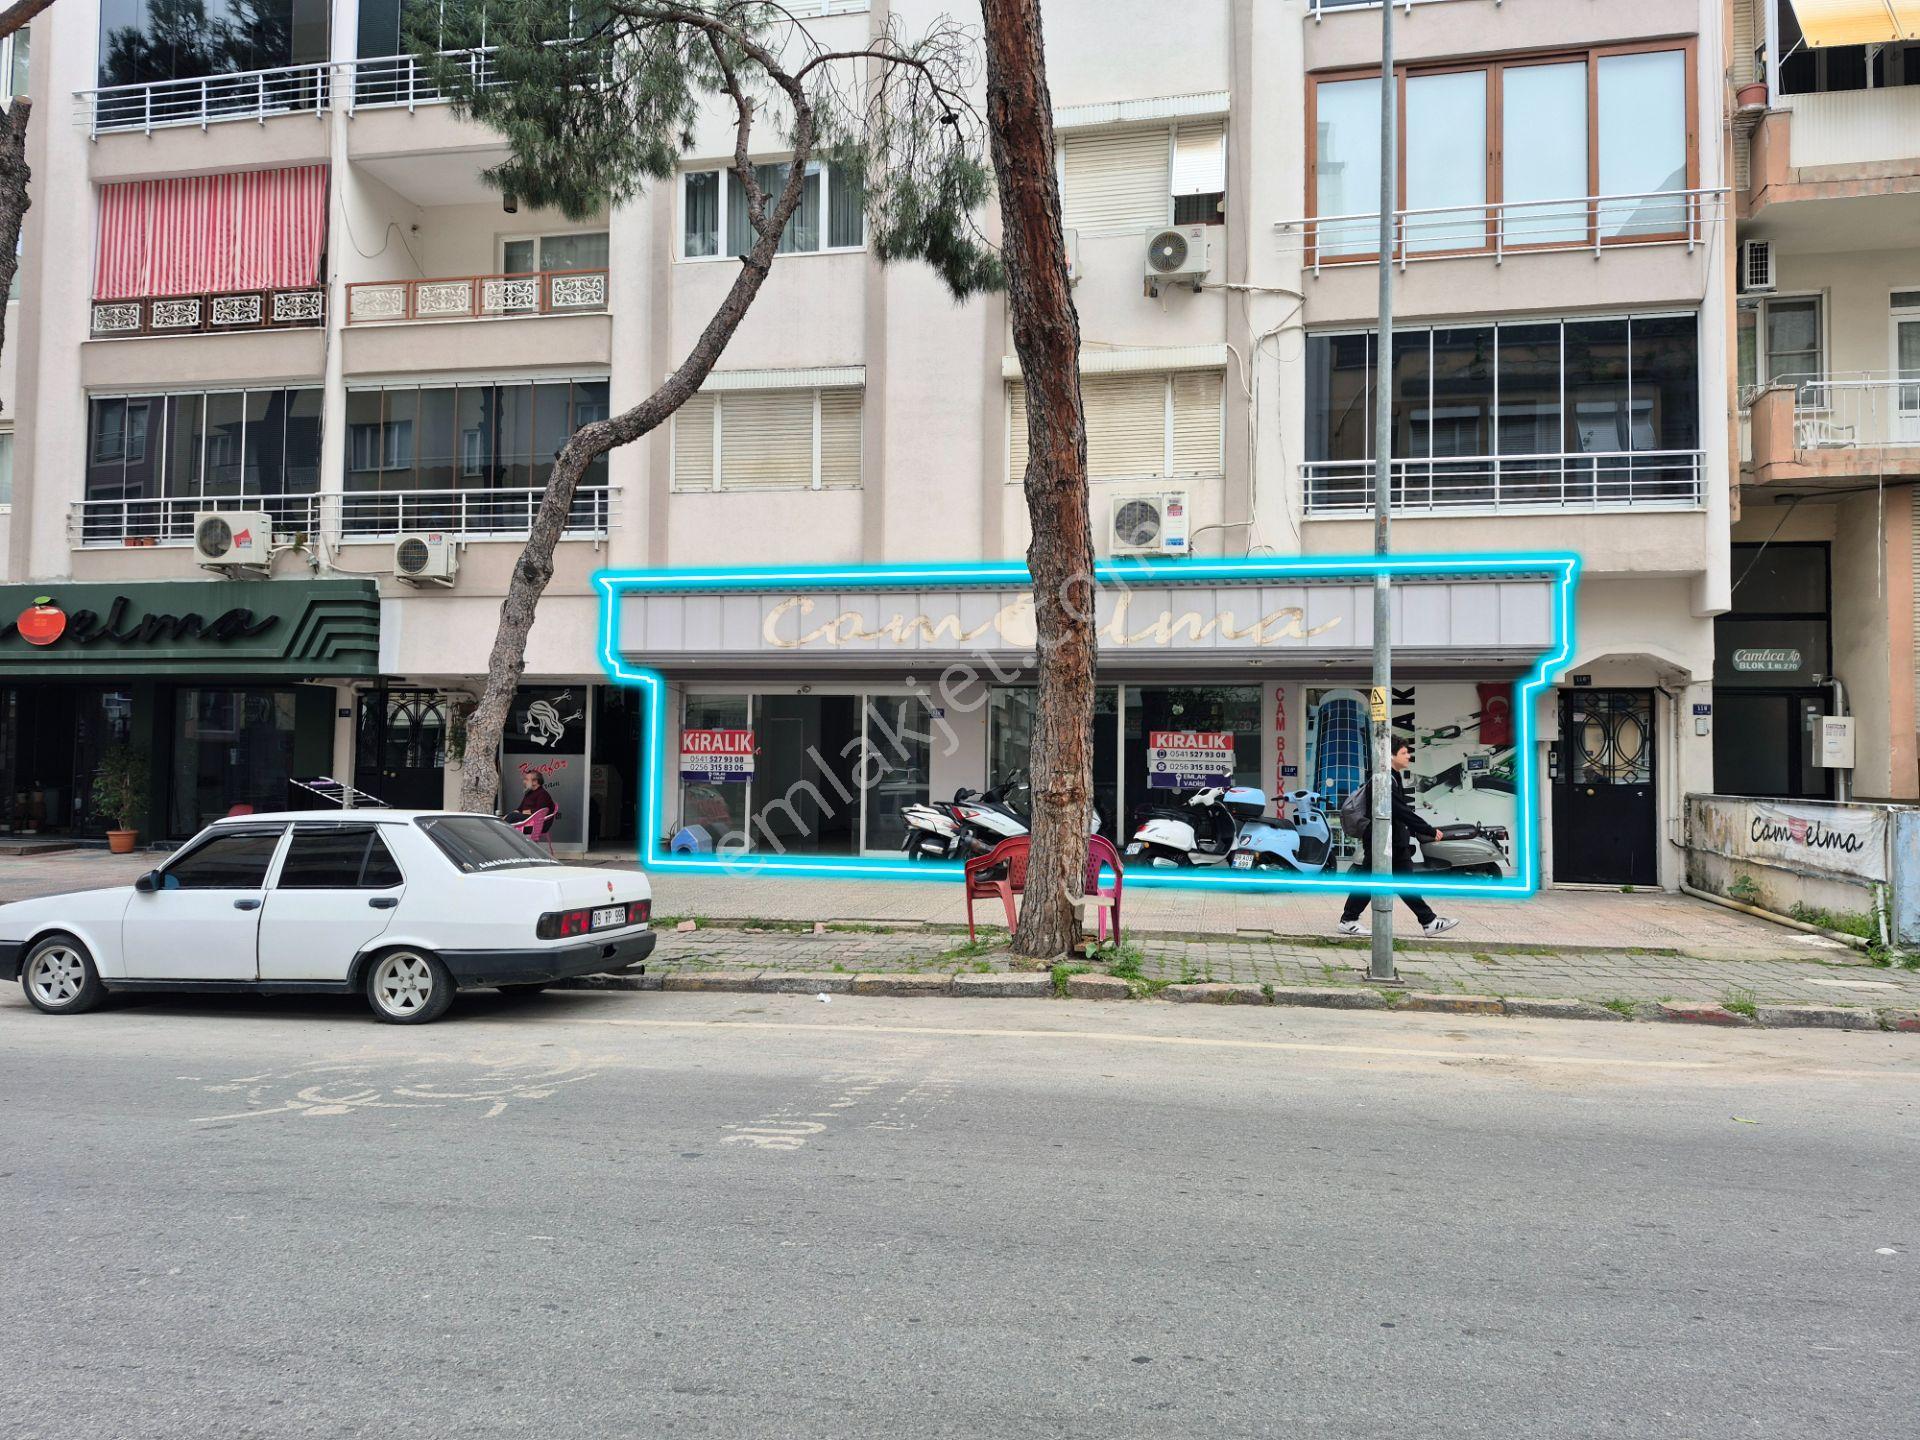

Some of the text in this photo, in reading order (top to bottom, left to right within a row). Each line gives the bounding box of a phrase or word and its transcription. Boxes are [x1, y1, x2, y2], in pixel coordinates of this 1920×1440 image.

[68, 595, 280, 644] elma
[1275, 688, 1285, 731] CAM
[709, 755, 723, 763] 527
[1751, 816, 1864, 853] Cam elma
